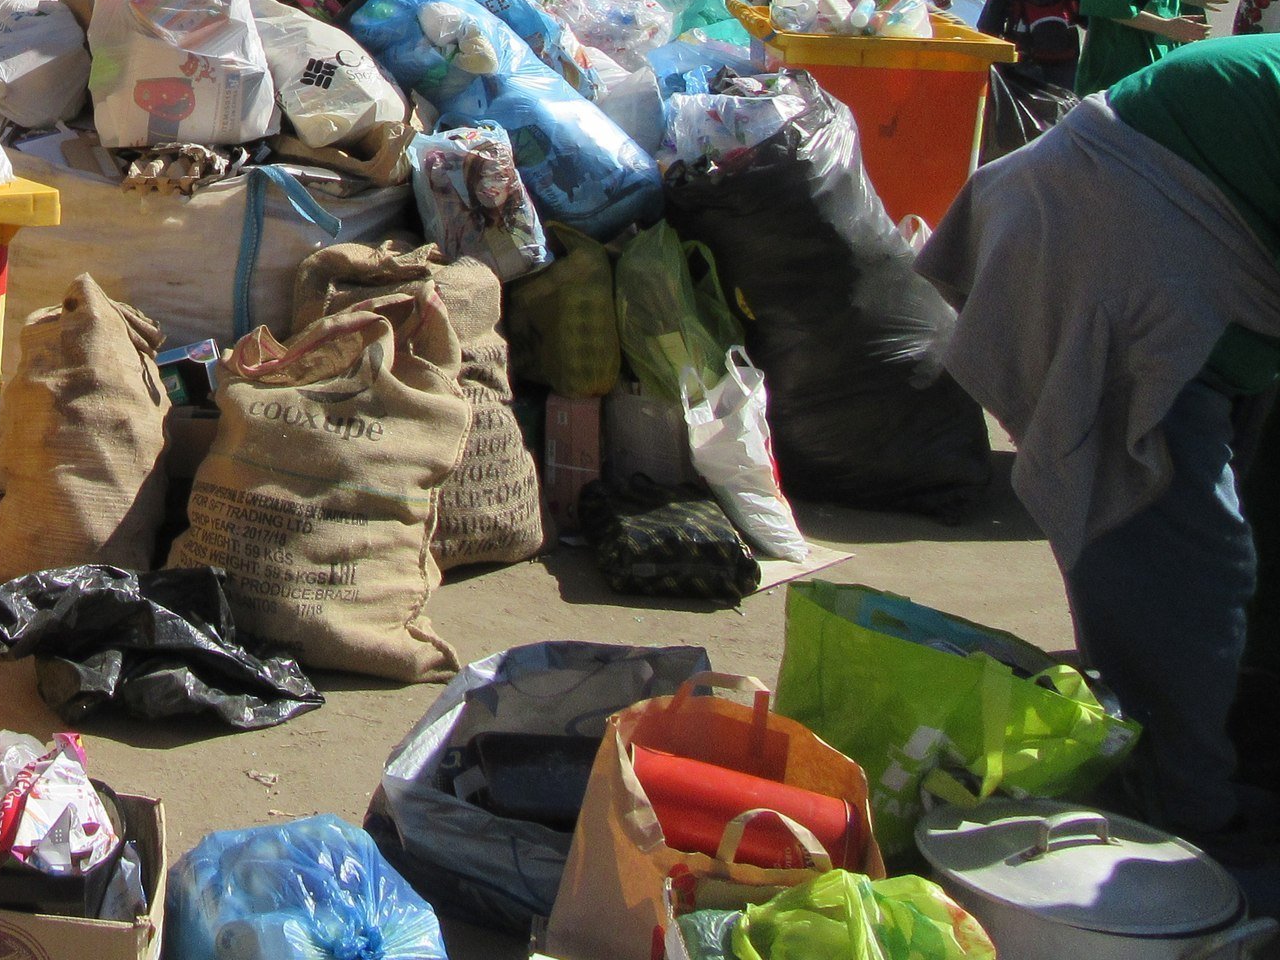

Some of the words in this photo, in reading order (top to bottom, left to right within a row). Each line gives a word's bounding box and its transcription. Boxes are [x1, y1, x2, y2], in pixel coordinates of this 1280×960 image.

[226, 503, 284, 528] TRADING
[287, 517, 313, 534] LTD
[245, 544, 260, 558] 59
[264, 547, 294, 565] KGS
